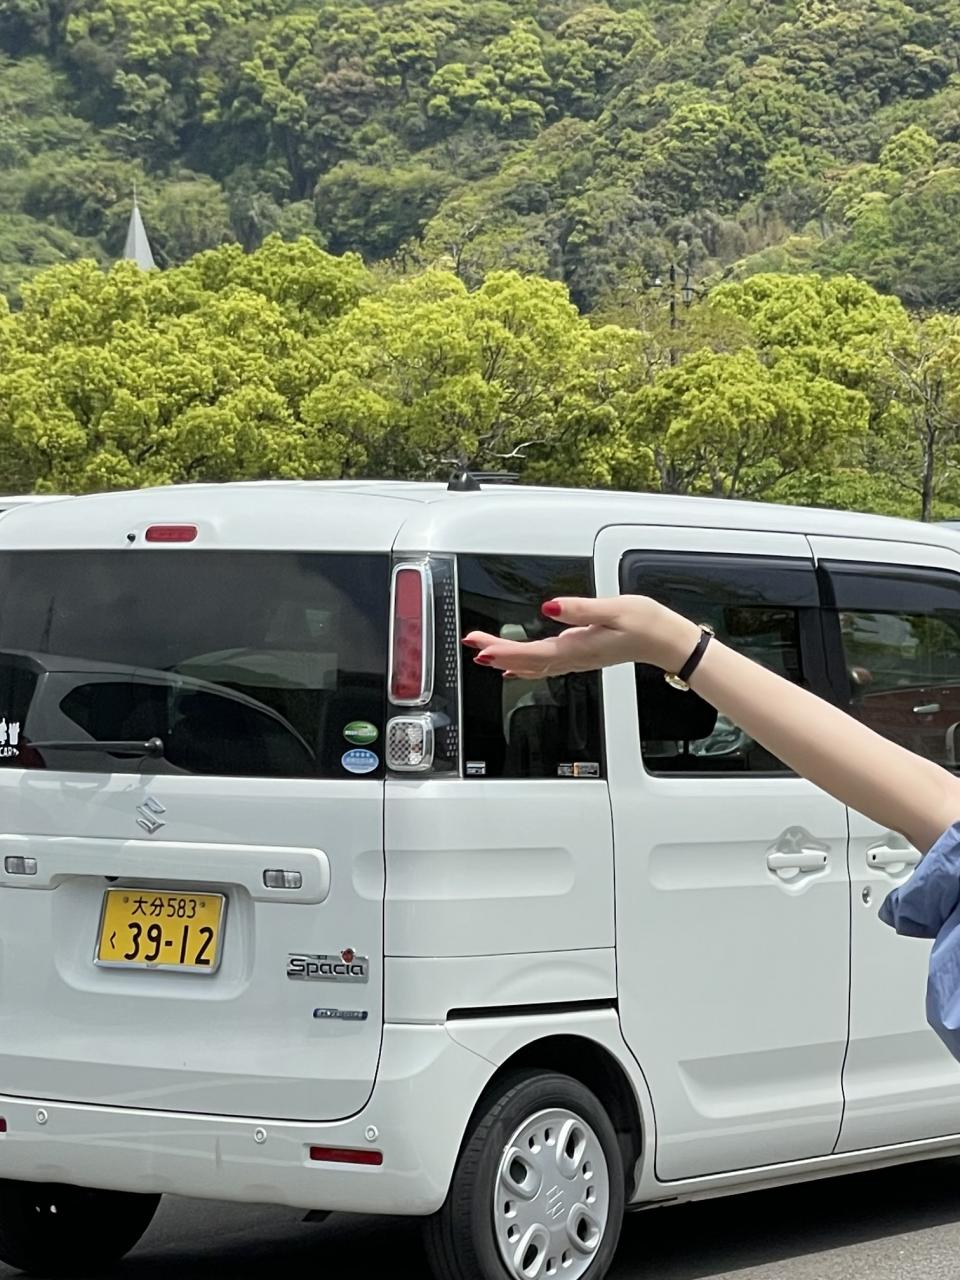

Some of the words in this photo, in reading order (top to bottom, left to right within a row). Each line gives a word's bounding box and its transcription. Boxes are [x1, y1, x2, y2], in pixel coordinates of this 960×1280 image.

[131, 896, 197, 919] 大分583
[124, 922, 214, 965] 39-12
[287, 958, 365, 977] Spacia
